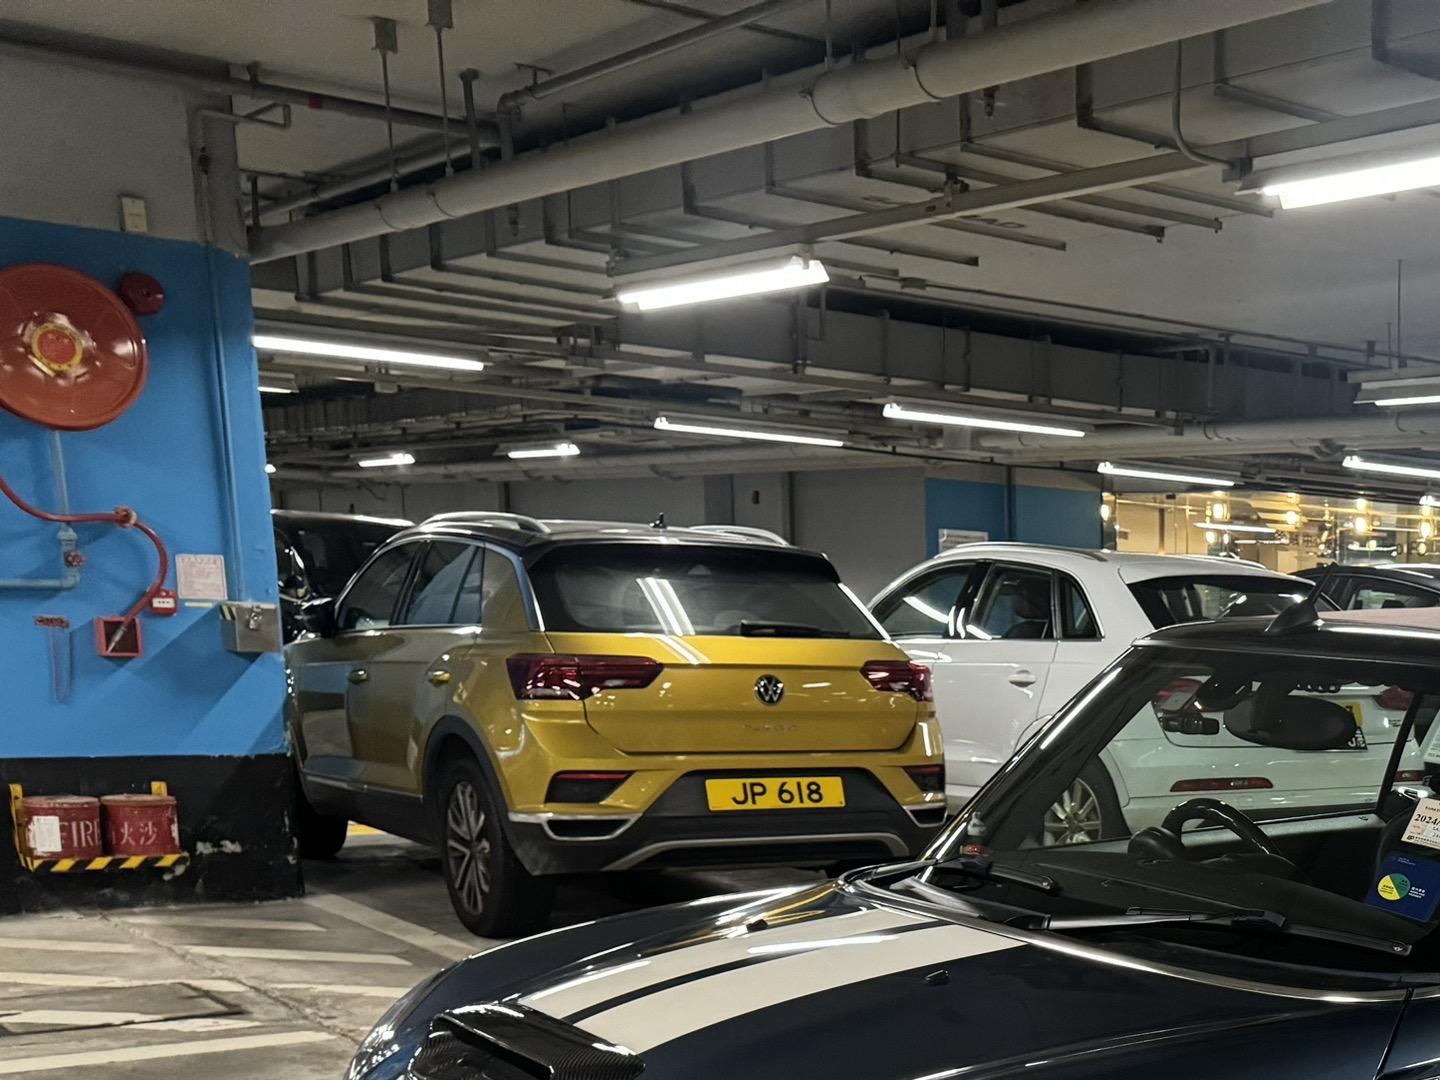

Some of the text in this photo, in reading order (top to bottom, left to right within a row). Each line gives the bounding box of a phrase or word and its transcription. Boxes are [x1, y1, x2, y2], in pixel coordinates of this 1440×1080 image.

[731, 781, 823, 805] JP 618
[112, 821, 158, 846] 火沙
